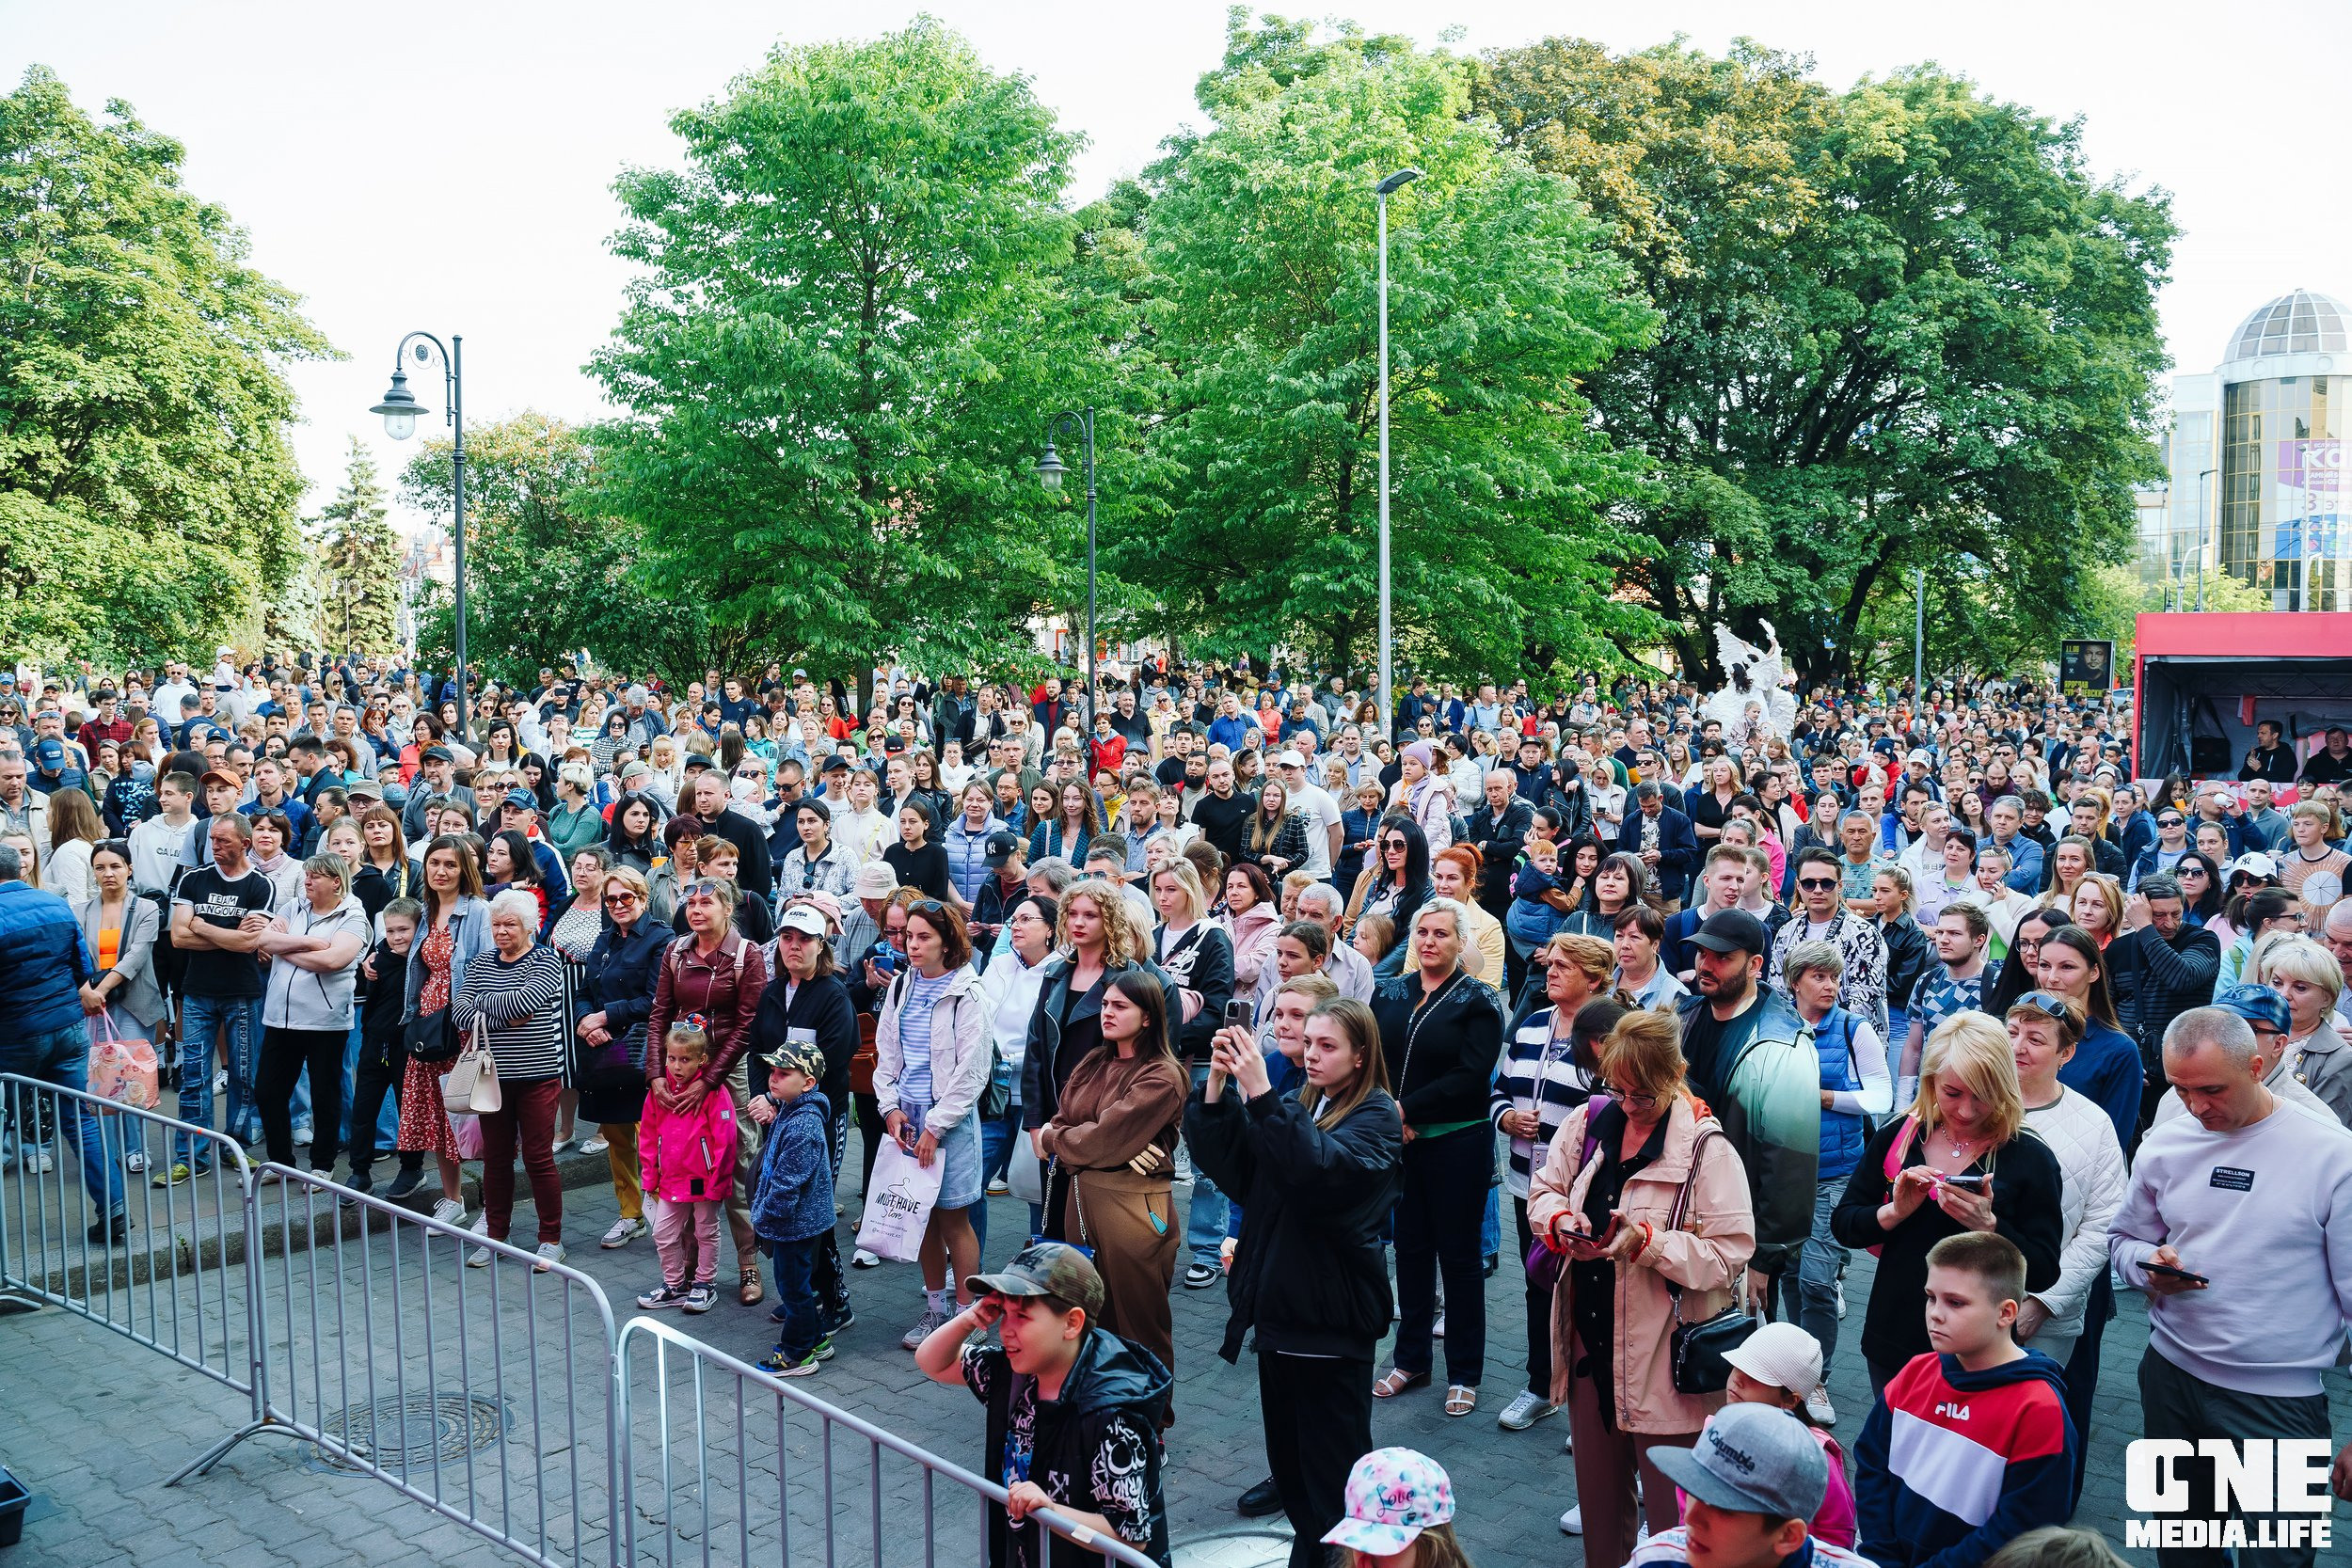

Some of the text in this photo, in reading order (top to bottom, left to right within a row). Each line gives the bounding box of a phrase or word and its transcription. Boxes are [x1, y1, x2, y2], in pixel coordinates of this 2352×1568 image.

[209, 893, 238, 906] TEAM
[2216, 1168, 2250, 1178] STRELLSON
[875, 1192, 921, 1214] MUST HAVE
[1934, 1401, 1970, 1420] FILA
[1708, 1429, 1756, 1472] Columbia
[1376, 1482, 1415, 1518] Love
